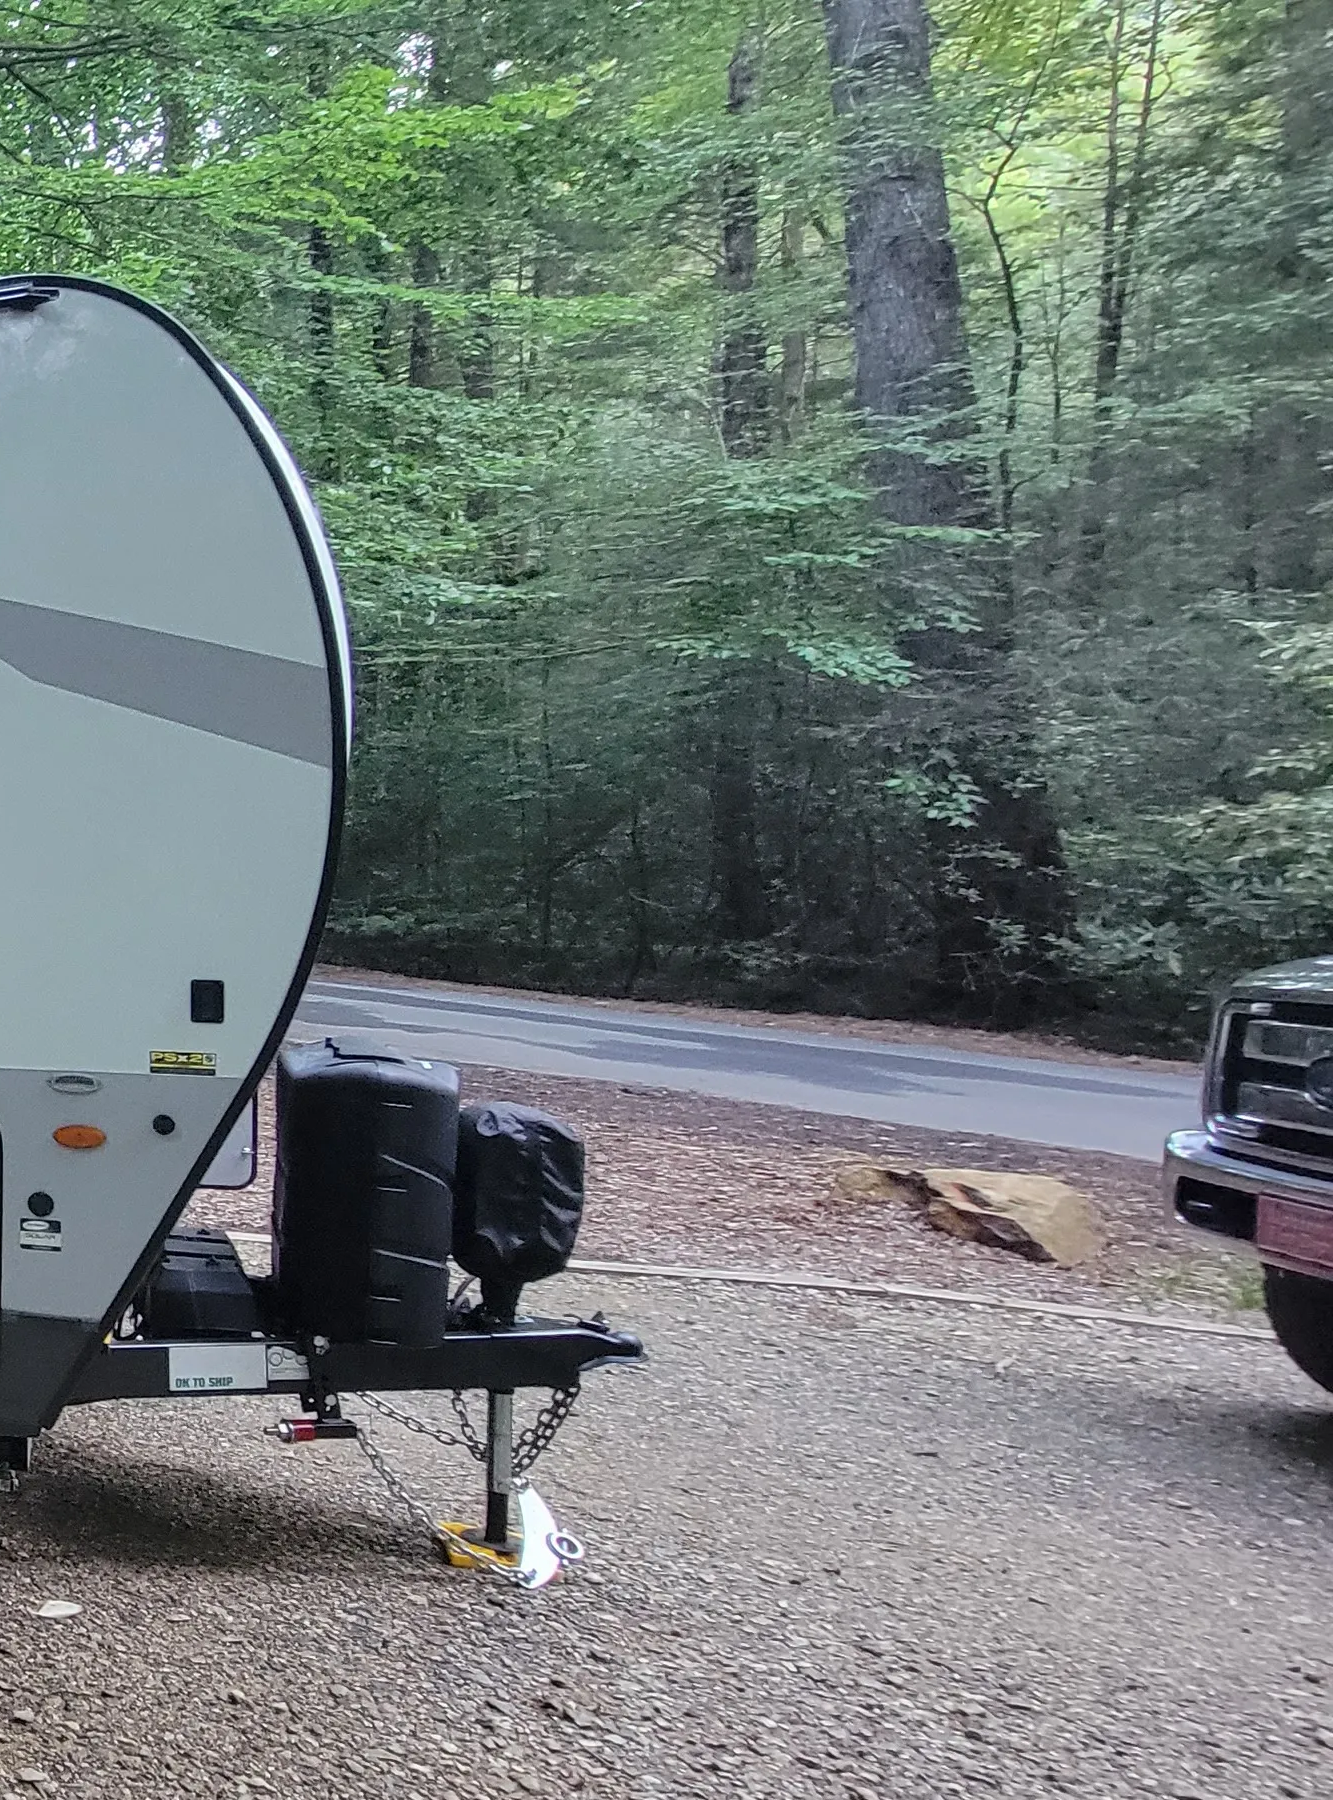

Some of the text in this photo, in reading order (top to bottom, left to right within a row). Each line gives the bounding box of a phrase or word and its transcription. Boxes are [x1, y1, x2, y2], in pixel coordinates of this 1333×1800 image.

[176, 1377, 233, 1388] OK TO SHIP
